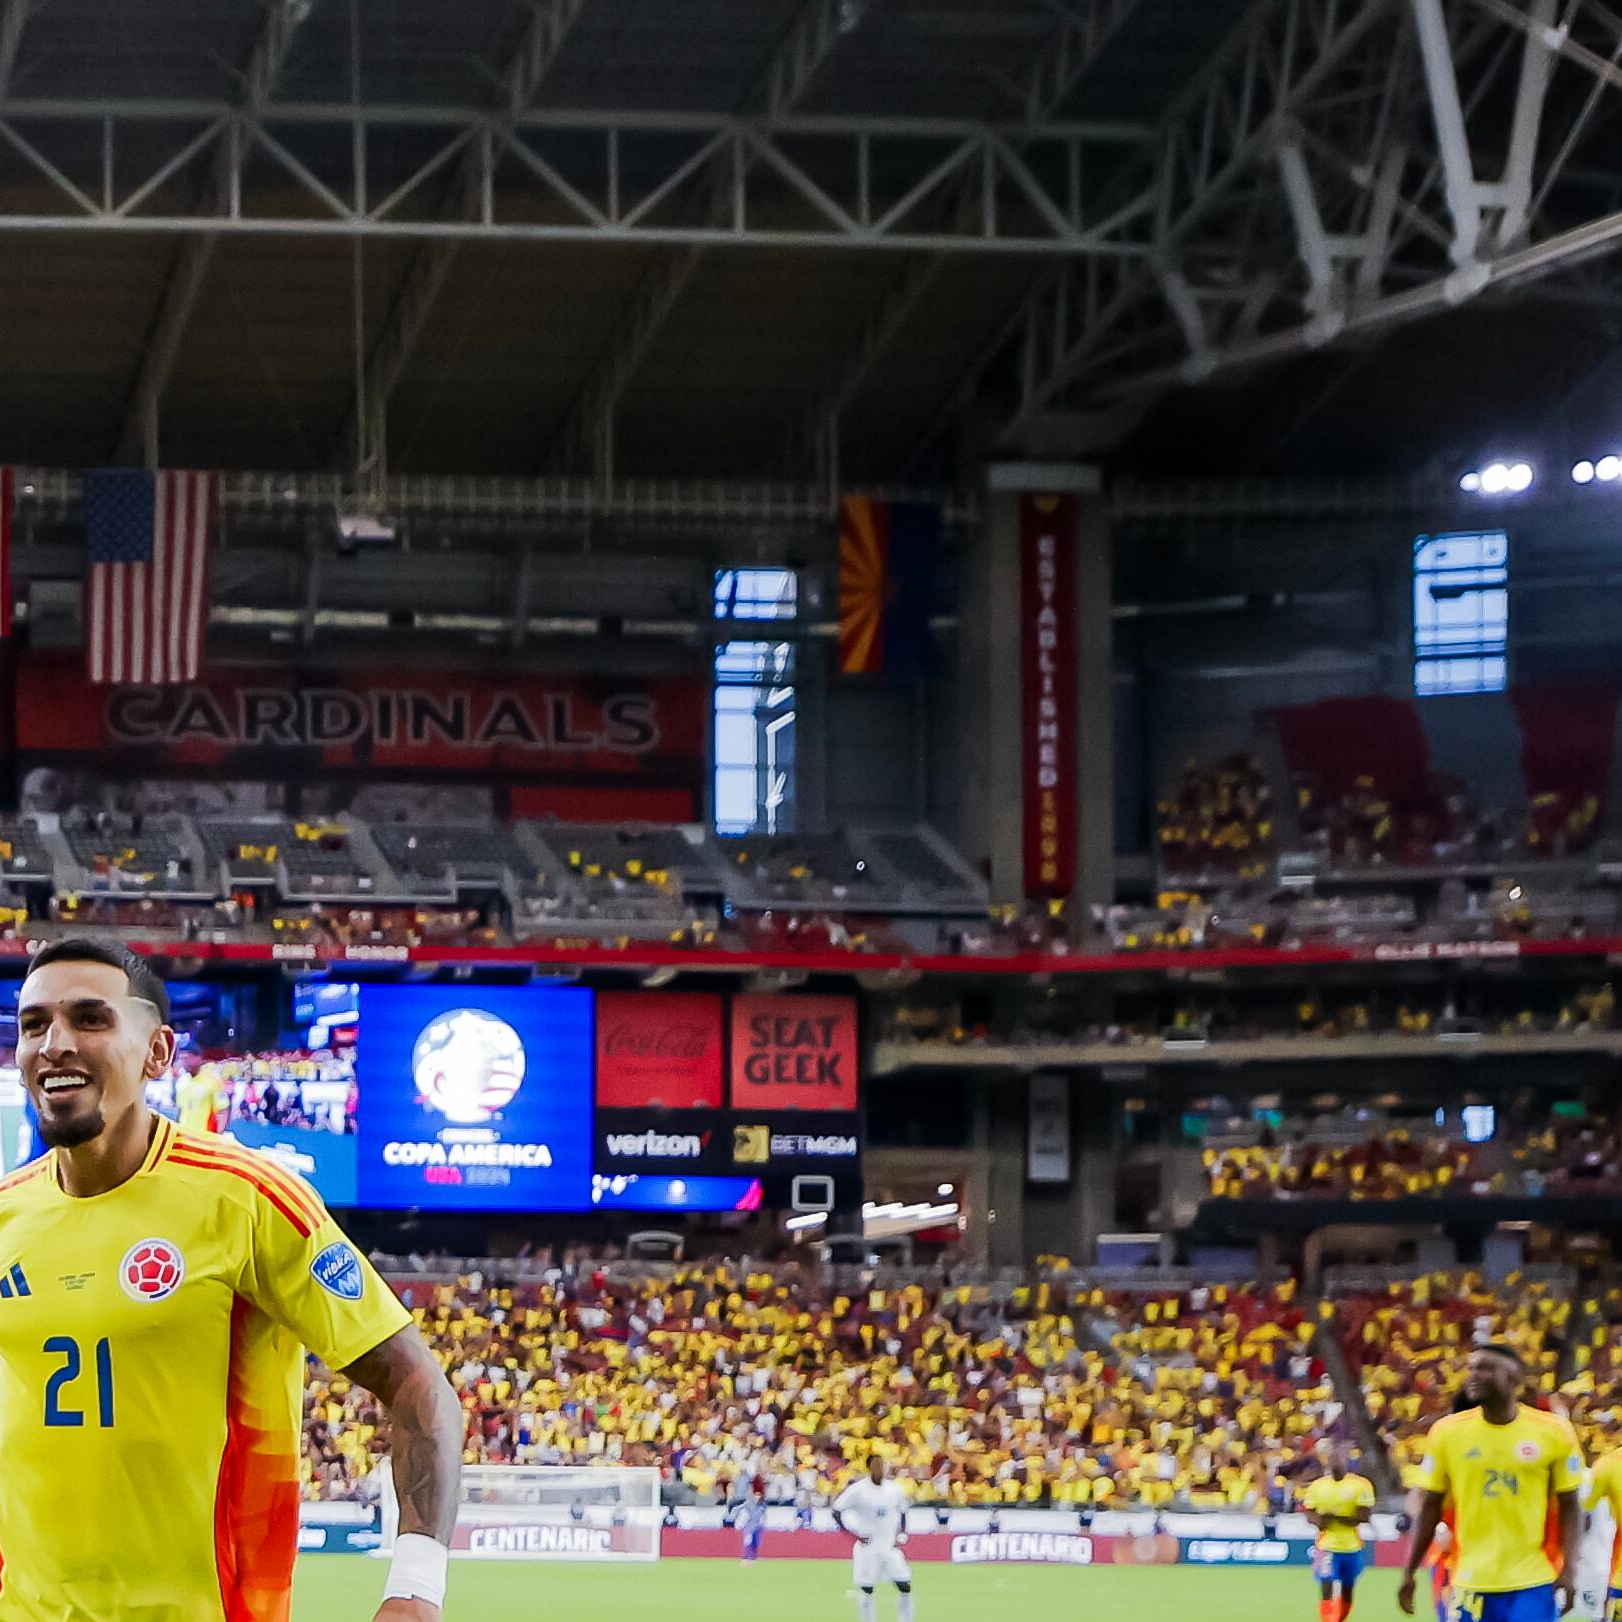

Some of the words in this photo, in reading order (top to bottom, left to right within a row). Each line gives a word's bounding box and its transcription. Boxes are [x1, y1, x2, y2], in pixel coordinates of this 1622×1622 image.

[103, 686, 661, 754] CARDINALS
[749, 1015, 840, 1048] SEAT
[744, 1053, 842, 1086] GEEK
[383, 1141, 447, 1166] COPA
[448, 1143, 553, 1167] AMERICA
[606, 1129, 701, 1156] verizon
[770, 1135, 857, 1156] BETMGM
[42, 1336, 114, 1427] 21
[1483, 1468, 1520, 1497] 24
[951, 1533, 1092, 1563] CENTENARIO
